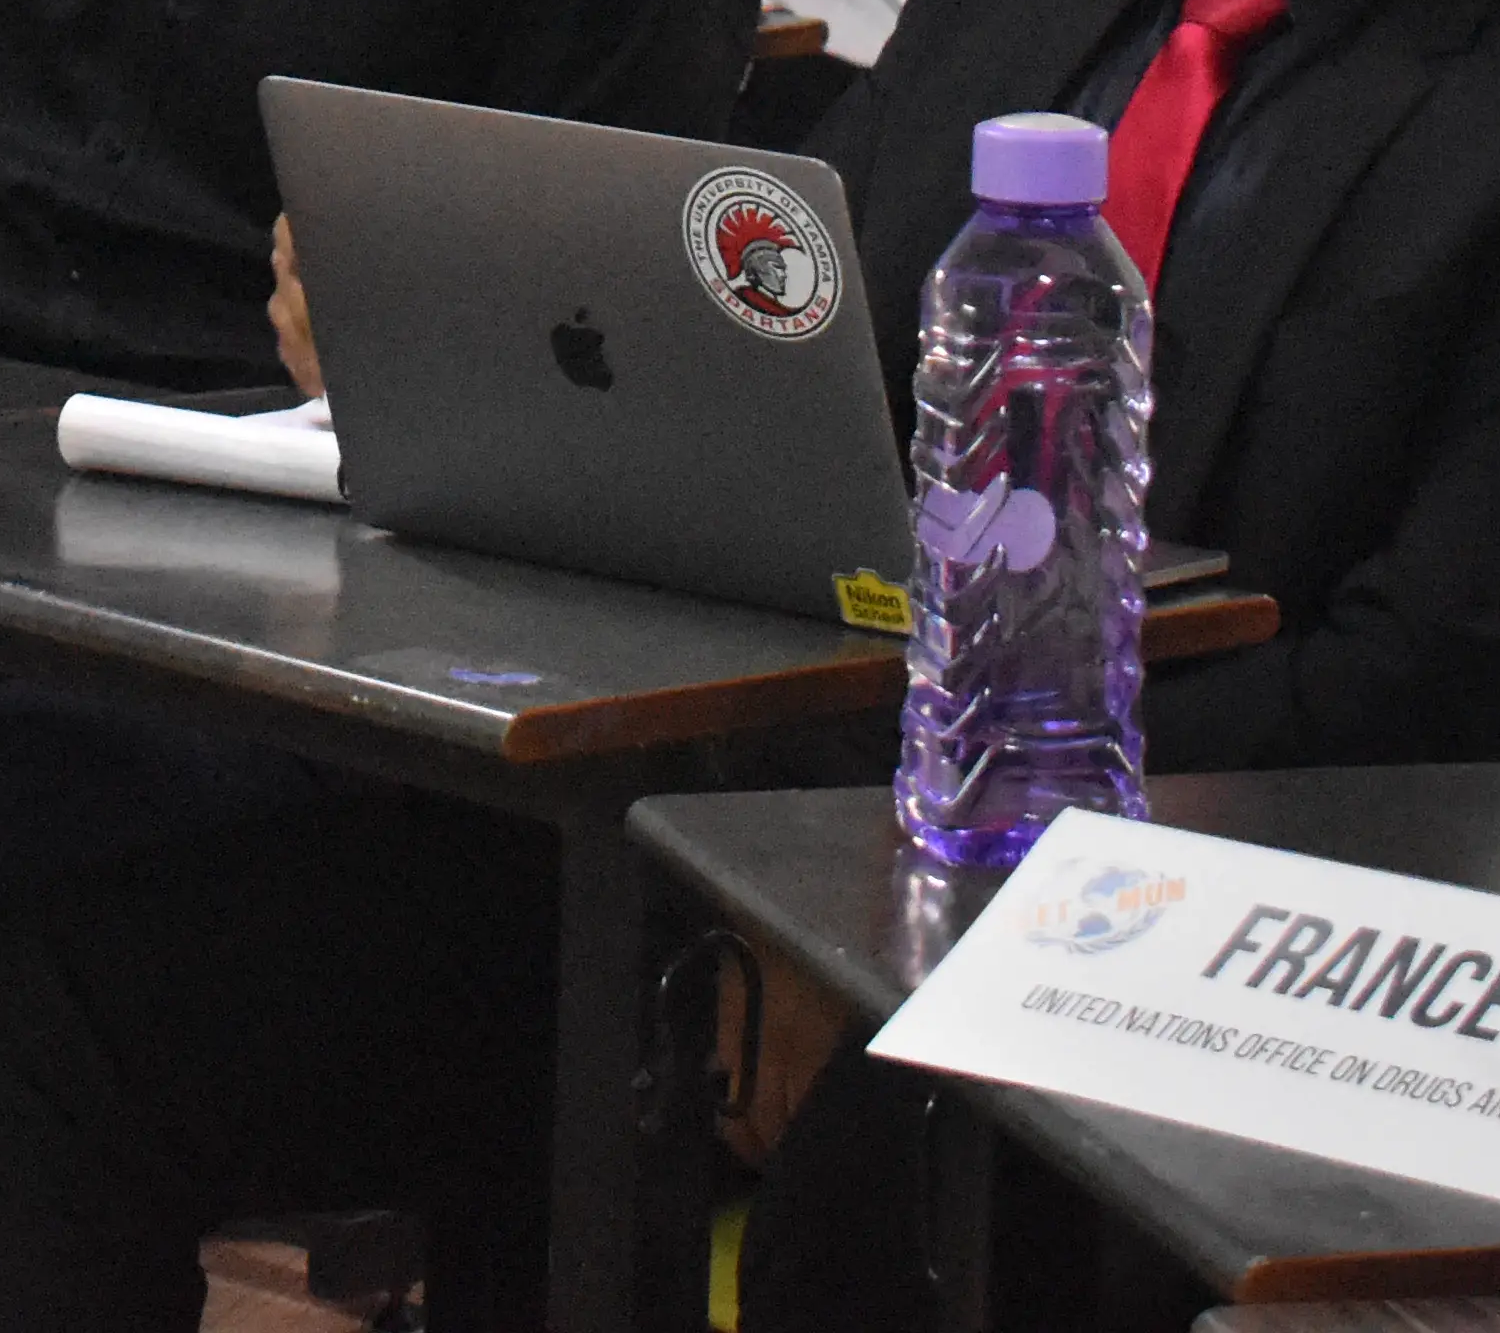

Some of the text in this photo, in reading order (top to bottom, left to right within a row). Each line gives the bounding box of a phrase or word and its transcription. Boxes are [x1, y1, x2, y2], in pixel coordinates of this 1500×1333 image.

[692, 177, 833, 283] THE UNIVERSITY OF TAMPA
[710, 277, 830, 332] SPARTANS
[845, 584, 902, 610] Nikon
[1021, 983, 1122, 1026] UNITED
[1115, 1005, 1239, 1054] NATIONS
[1233, 1032, 1336, 1075] OFFICE
[1330, 1054, 1380, 1085] ON
[1371, 1063, 1474, 1109] DRUGS
